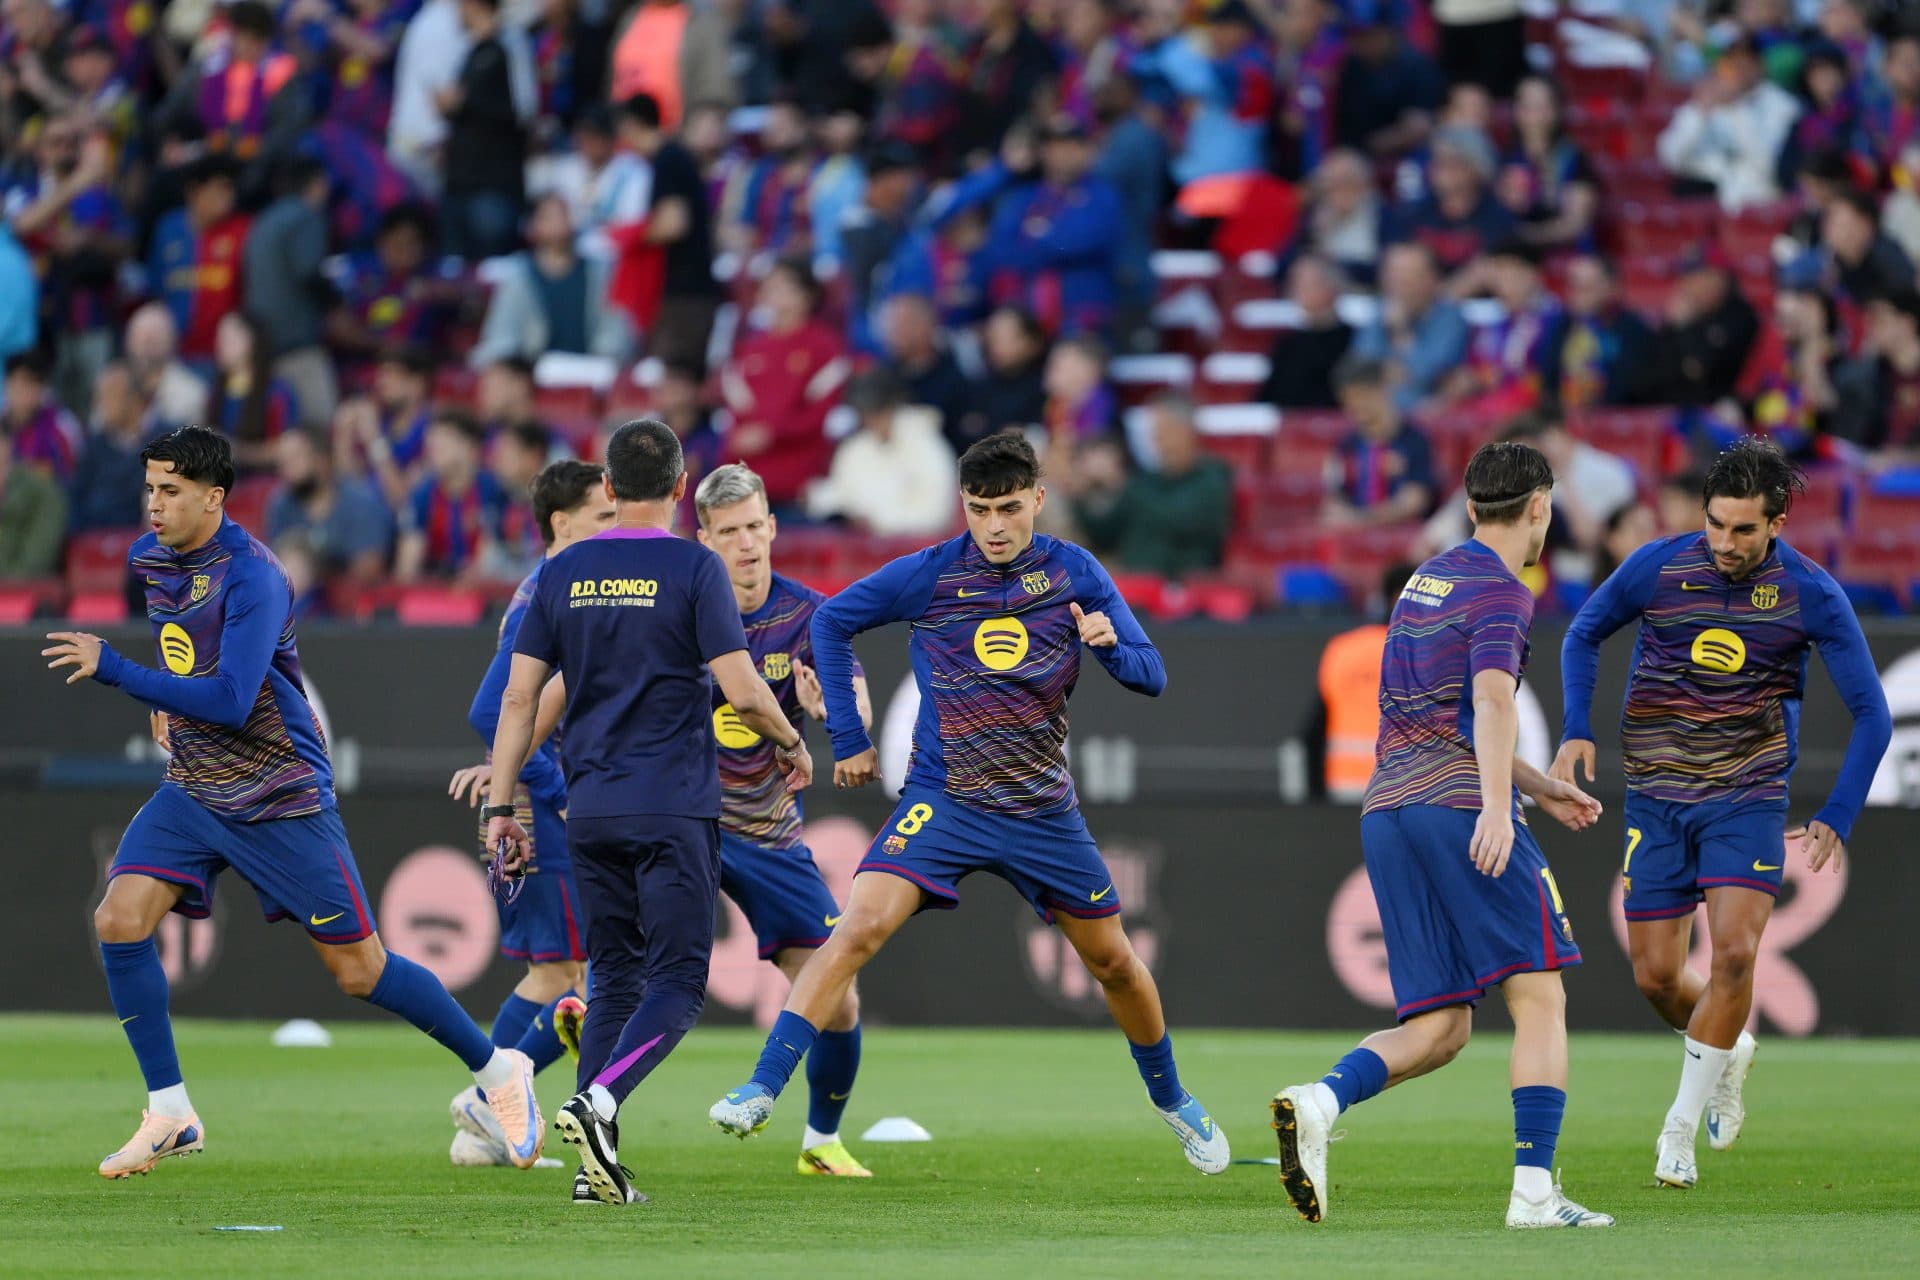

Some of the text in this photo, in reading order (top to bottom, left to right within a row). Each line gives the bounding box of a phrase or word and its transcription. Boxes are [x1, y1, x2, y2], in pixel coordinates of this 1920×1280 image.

[570, 579, 658, 598] R.D. CONGO
[896, 802, 933, 836] 8
[1623, 826, 1642, 873] 7
